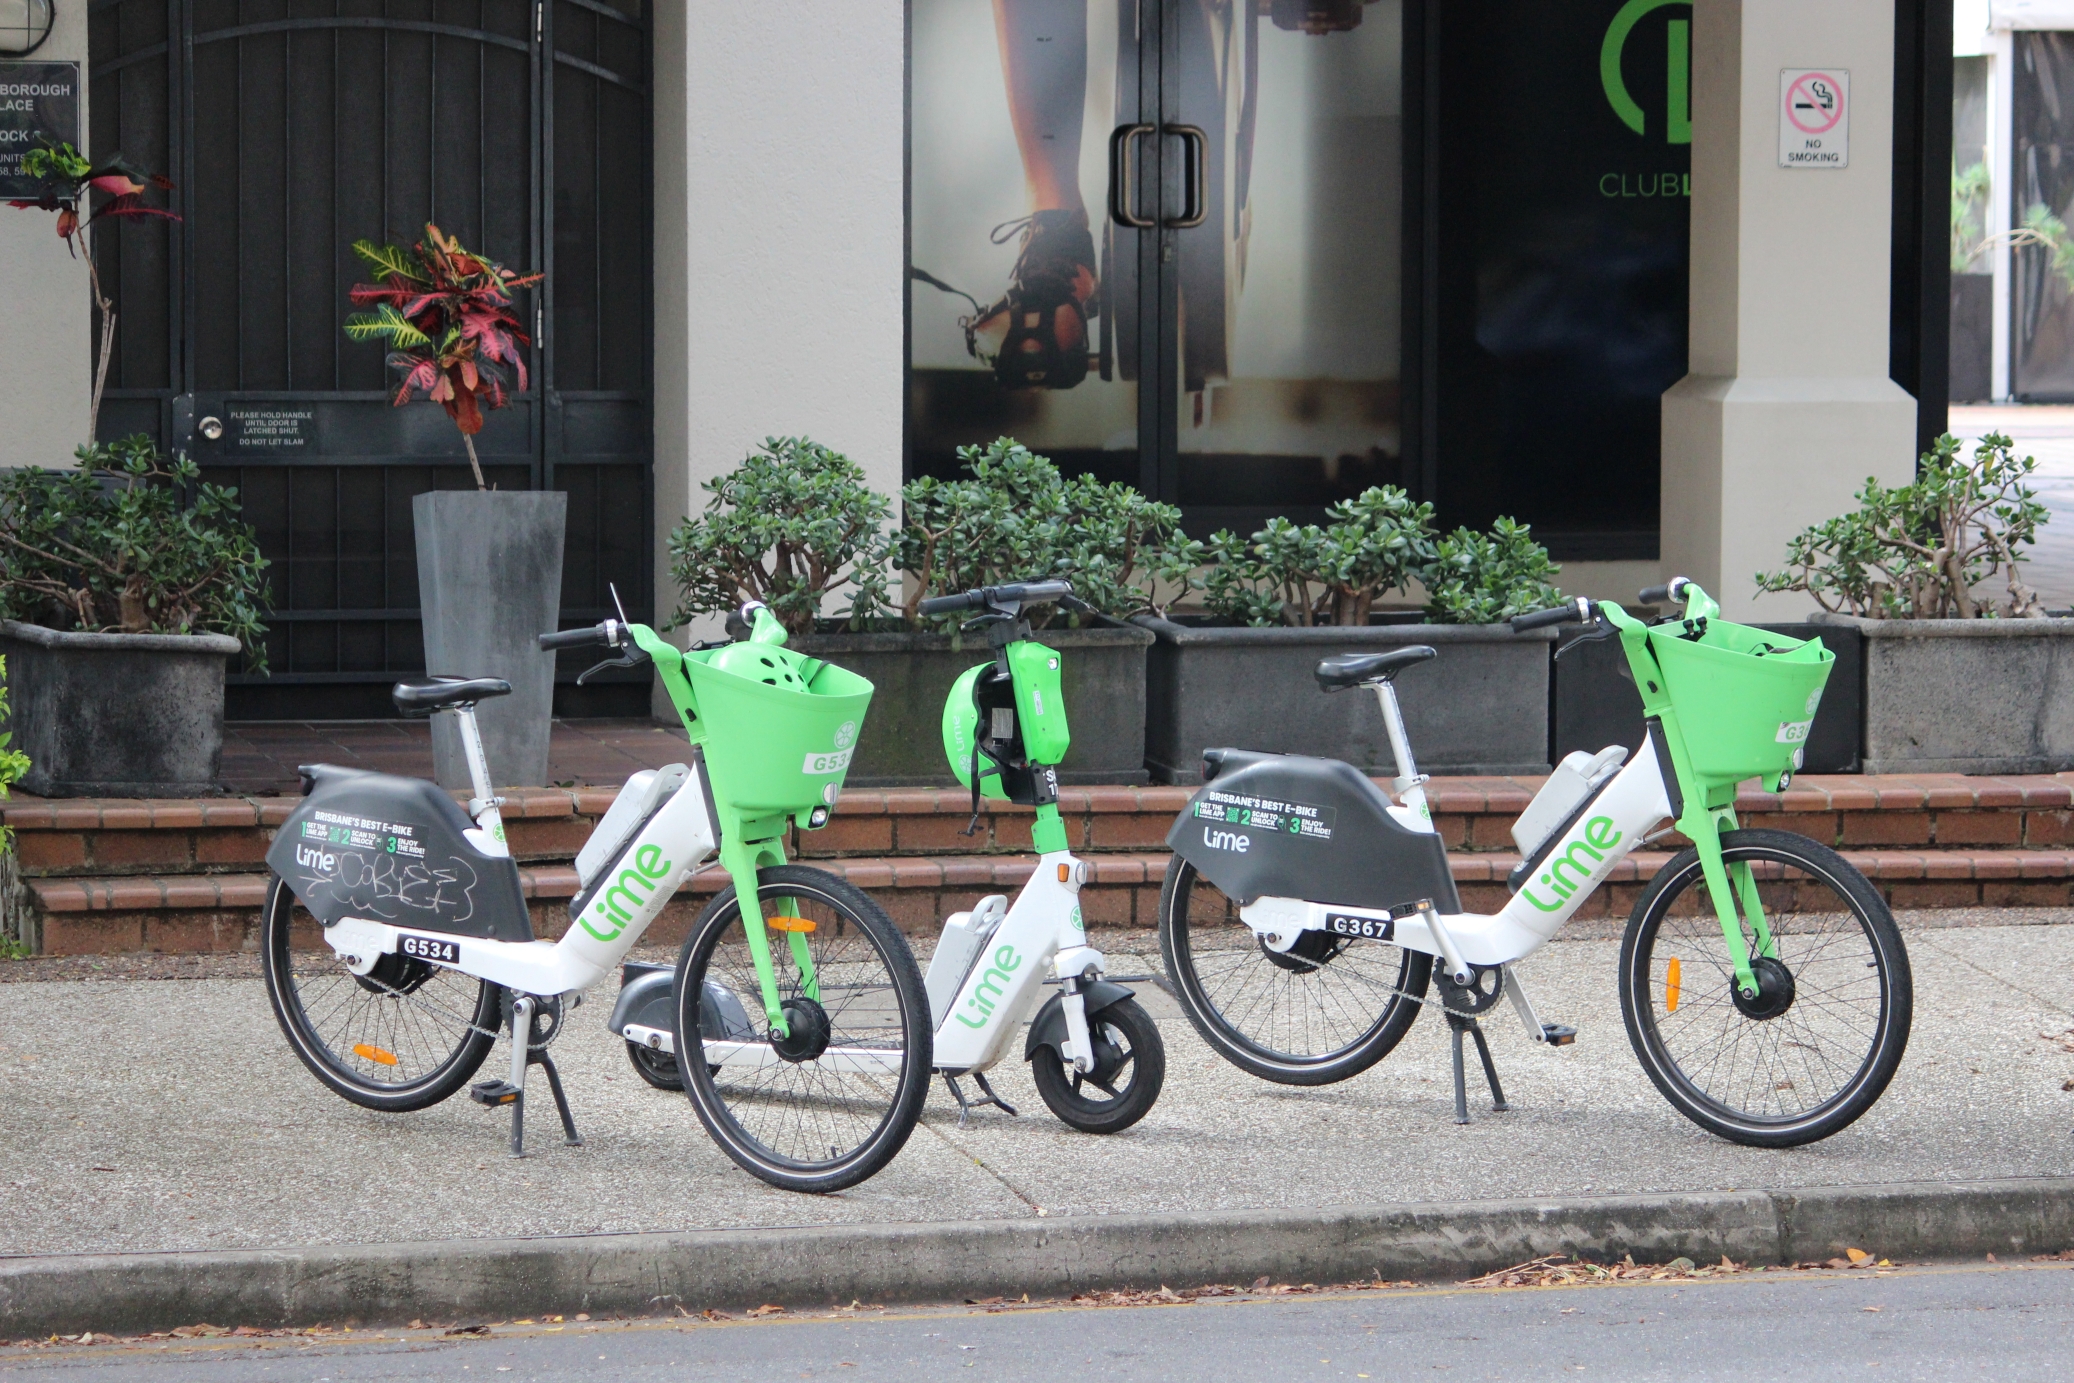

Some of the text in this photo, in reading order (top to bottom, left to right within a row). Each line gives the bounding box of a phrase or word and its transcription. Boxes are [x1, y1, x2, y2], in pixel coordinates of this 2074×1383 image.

[1805, 139, 1821, 148] NO
[1788, 152, 1839, 162] SMOKING
[243, 427, 277, 435] LATCHED
[239, 438, 304, 446] DO NOT LET SLAM
[1194, 801, 1200, 817] 1
[1209, 791, 1318, 818] BRISBANE'S BEST E-BIKE
[1211, 803, 1223, 811] THE
[1241, 809, 1251, 825] 2
[1250, 817, 1275, 826] UNLOCK
[1251, 811, 1269, 819] SCAN
[301, 821, 307, 837] 1
[314, 811, 413, 836] BRISBANE'S BEST E-BIKE
[316, 823, 327, 831] THE
[1289, 817, 1300, 834] 3
[1301, 818, 1324, 827] ENJOY
[306, 828, 318, 836] LIME
[341, 829, 351, 845] 2
[351, 830, 368, 839] SCAN
[1301, 825, 1313, 833] THE
[1313, 827, 1331, 836] RIDE!
[350, 836, 374, 846] UNLOCK
[386, 836, 397, 853] 3
[397, 838, 419, 847] ENJOY
[1203, 826, 1250, 852] Lime
[397, 844, 409, 852] THE
[408, 846, 426, 855] RIDE!
[296, 843, 335, 871] Lime
[1521, 816, 1622, 912] Lime
[578, 844, 671, 942] Lime
[1333, 917, 1387, 937] G367
[404, 937, 453, 960] G534
[955, 945, 1022, 1029] Lime
